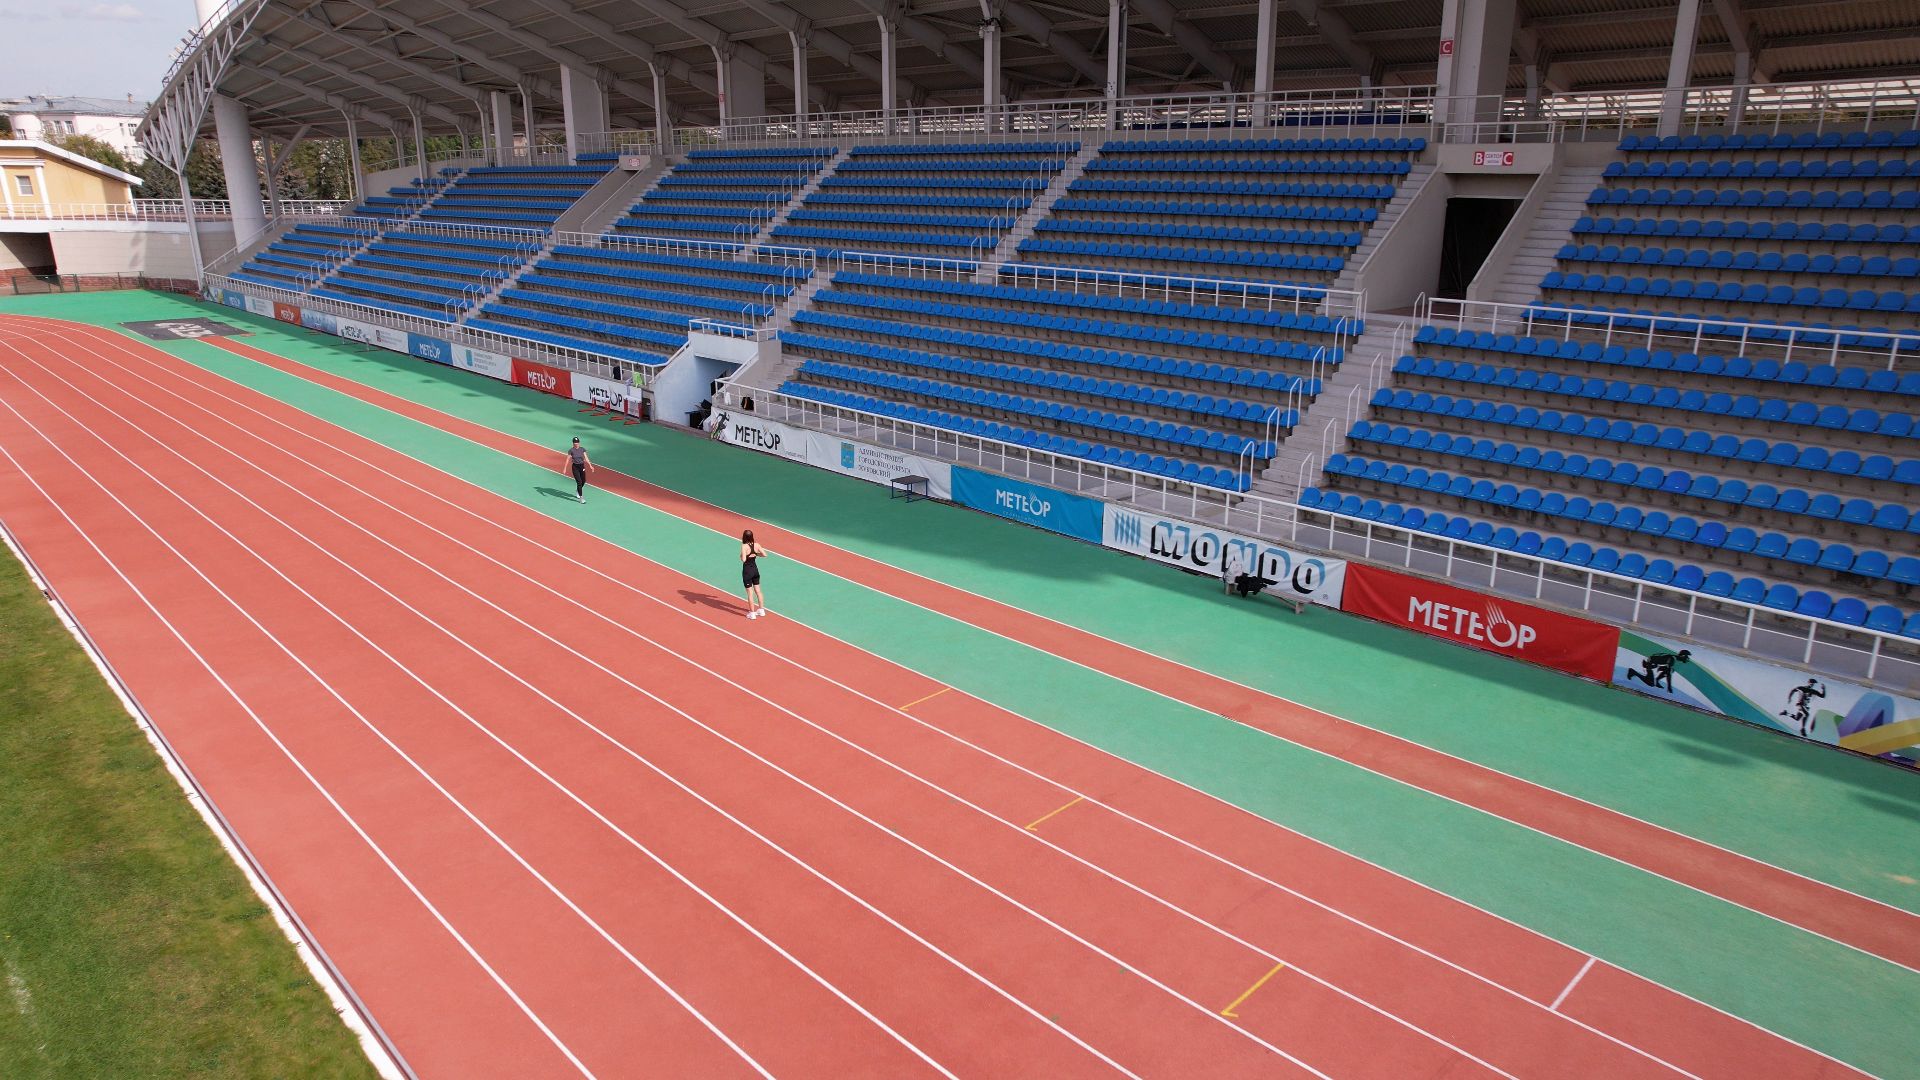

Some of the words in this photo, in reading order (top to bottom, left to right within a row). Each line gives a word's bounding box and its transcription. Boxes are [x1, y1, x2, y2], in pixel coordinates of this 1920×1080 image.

[527, 370, 556, 390] МЕТЕОР
[734, 423, 781, 451] МЕТЕОР
[995, 488, 1051, 518] МЕТЕОР
[1150, 521, 1326, 594] MONDO
[1407, 596, 1537, 649] МЕТЕОР
